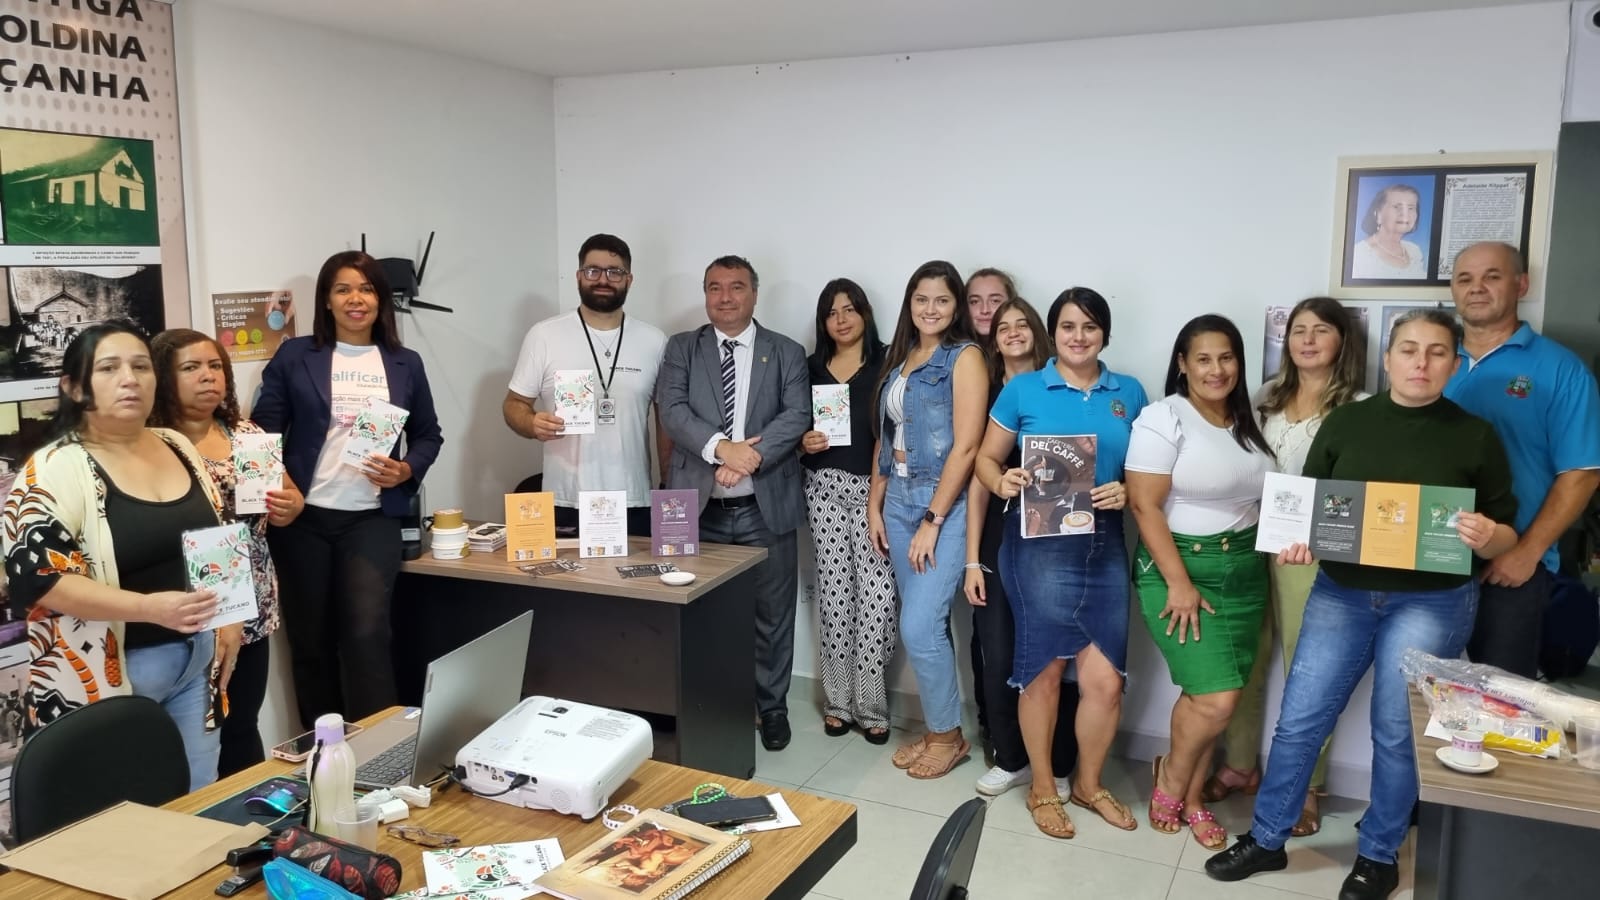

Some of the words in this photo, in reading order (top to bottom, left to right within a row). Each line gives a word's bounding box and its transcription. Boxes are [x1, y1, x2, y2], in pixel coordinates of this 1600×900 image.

[0, 14, 147, 62] OLDINA
[0, 58, 150, 102] ÇANHA
[1030, 440, 1050, 452] DEL
